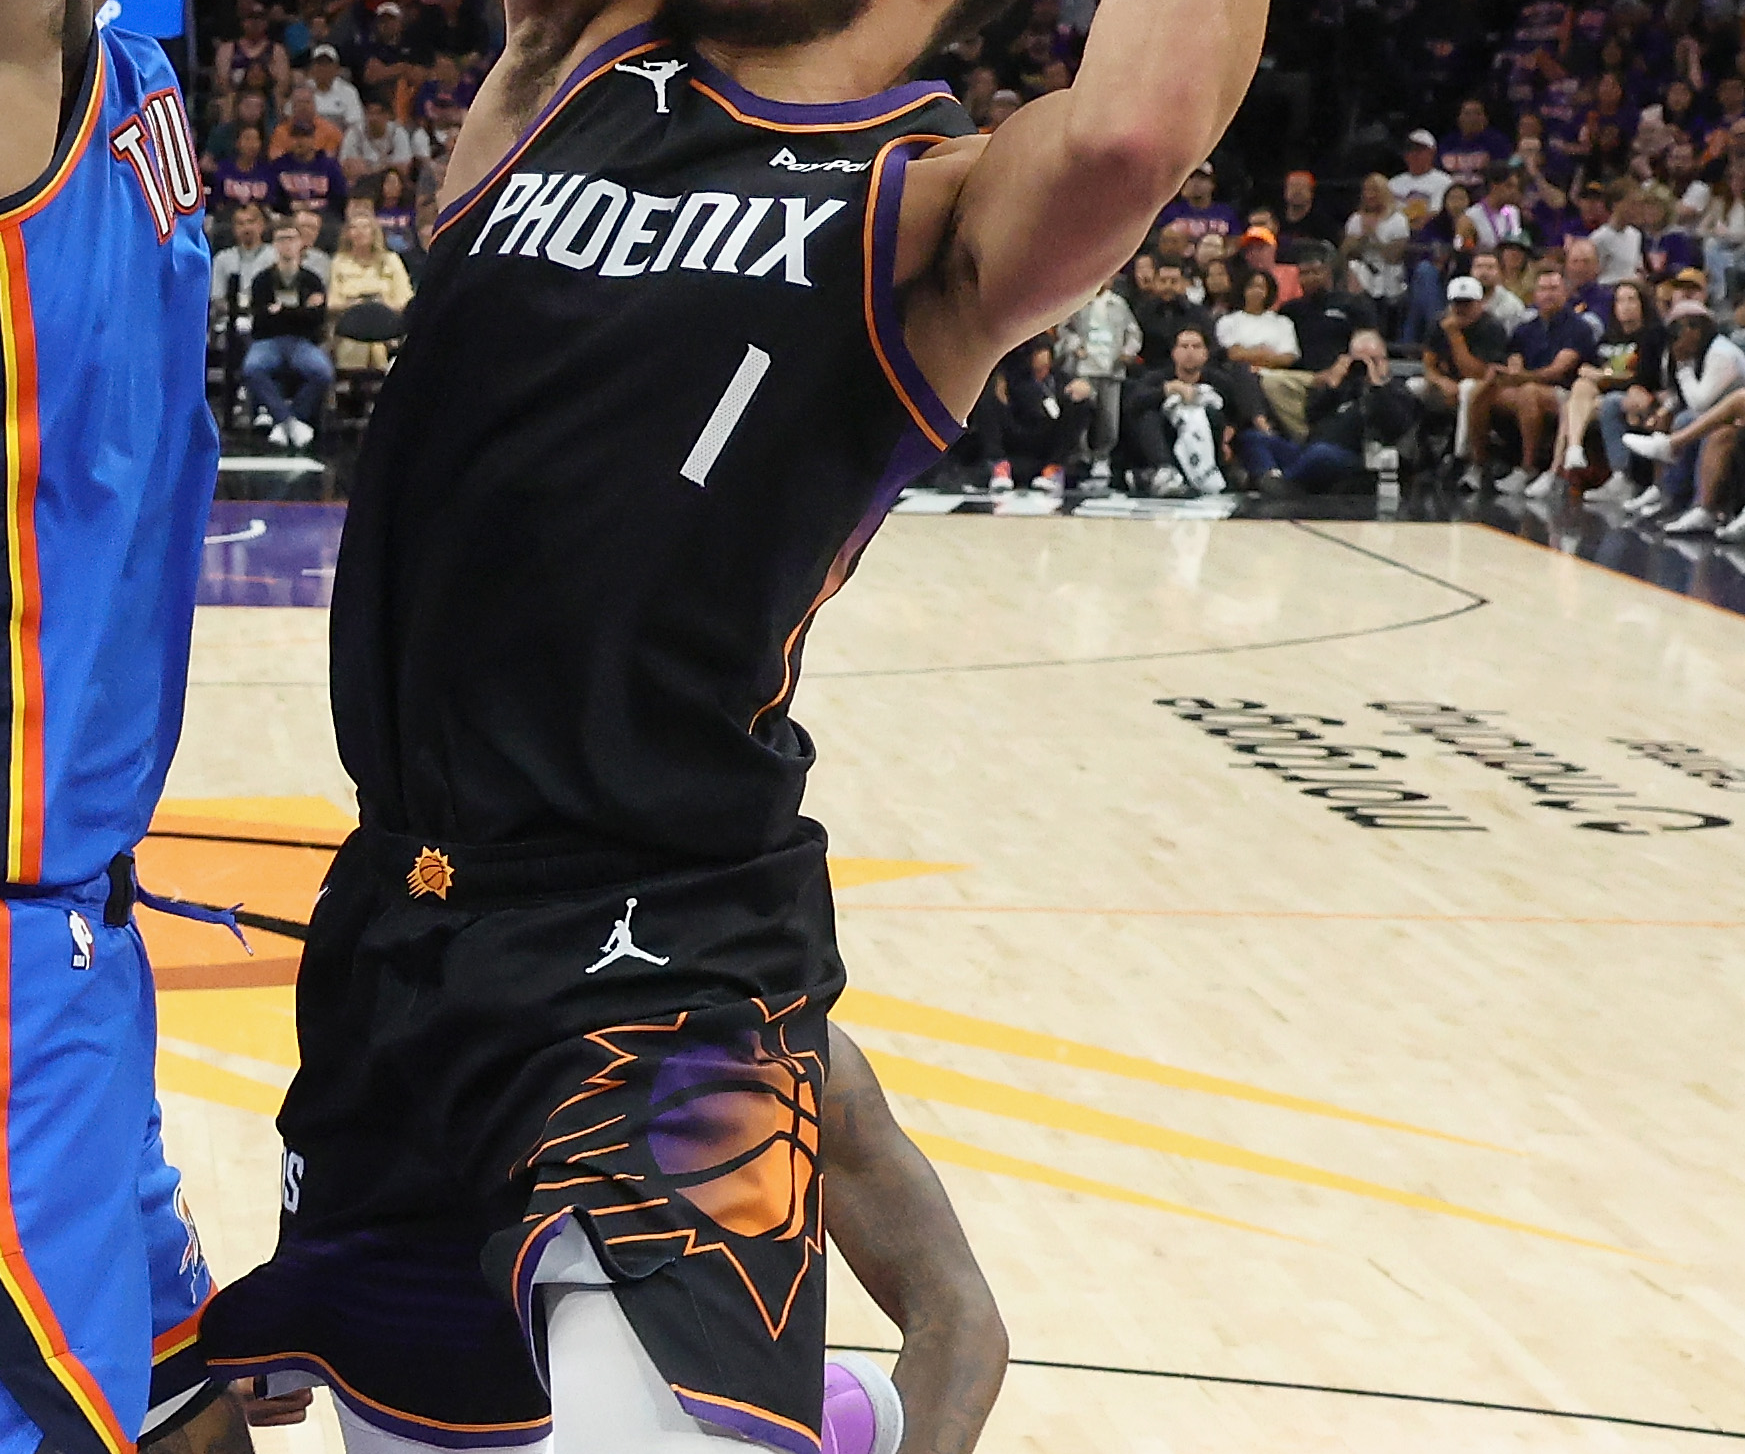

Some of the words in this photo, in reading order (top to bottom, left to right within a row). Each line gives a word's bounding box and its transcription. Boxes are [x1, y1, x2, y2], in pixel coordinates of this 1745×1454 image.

[768, 146, 873, 173] PayPal
[469, 172, 849, 287] PHOENIX
[680, 343, 772, 488] 1
